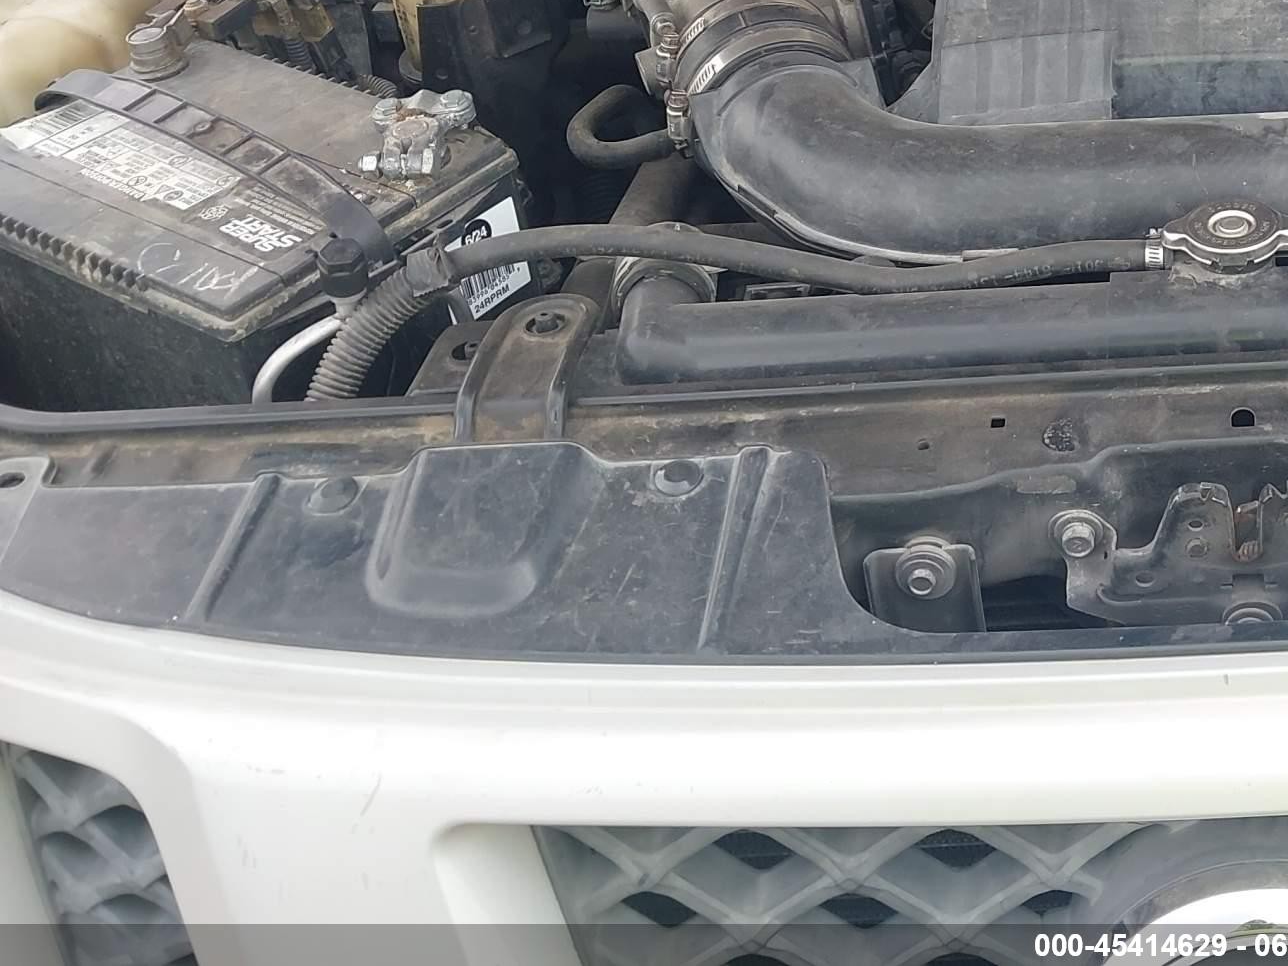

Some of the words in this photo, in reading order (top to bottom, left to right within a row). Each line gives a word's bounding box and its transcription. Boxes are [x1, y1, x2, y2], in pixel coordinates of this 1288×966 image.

[219, 219, 275, 252] SUPER
[239, 217, 303, 248] START
[474, 284, 510, 313] 24RPRM
